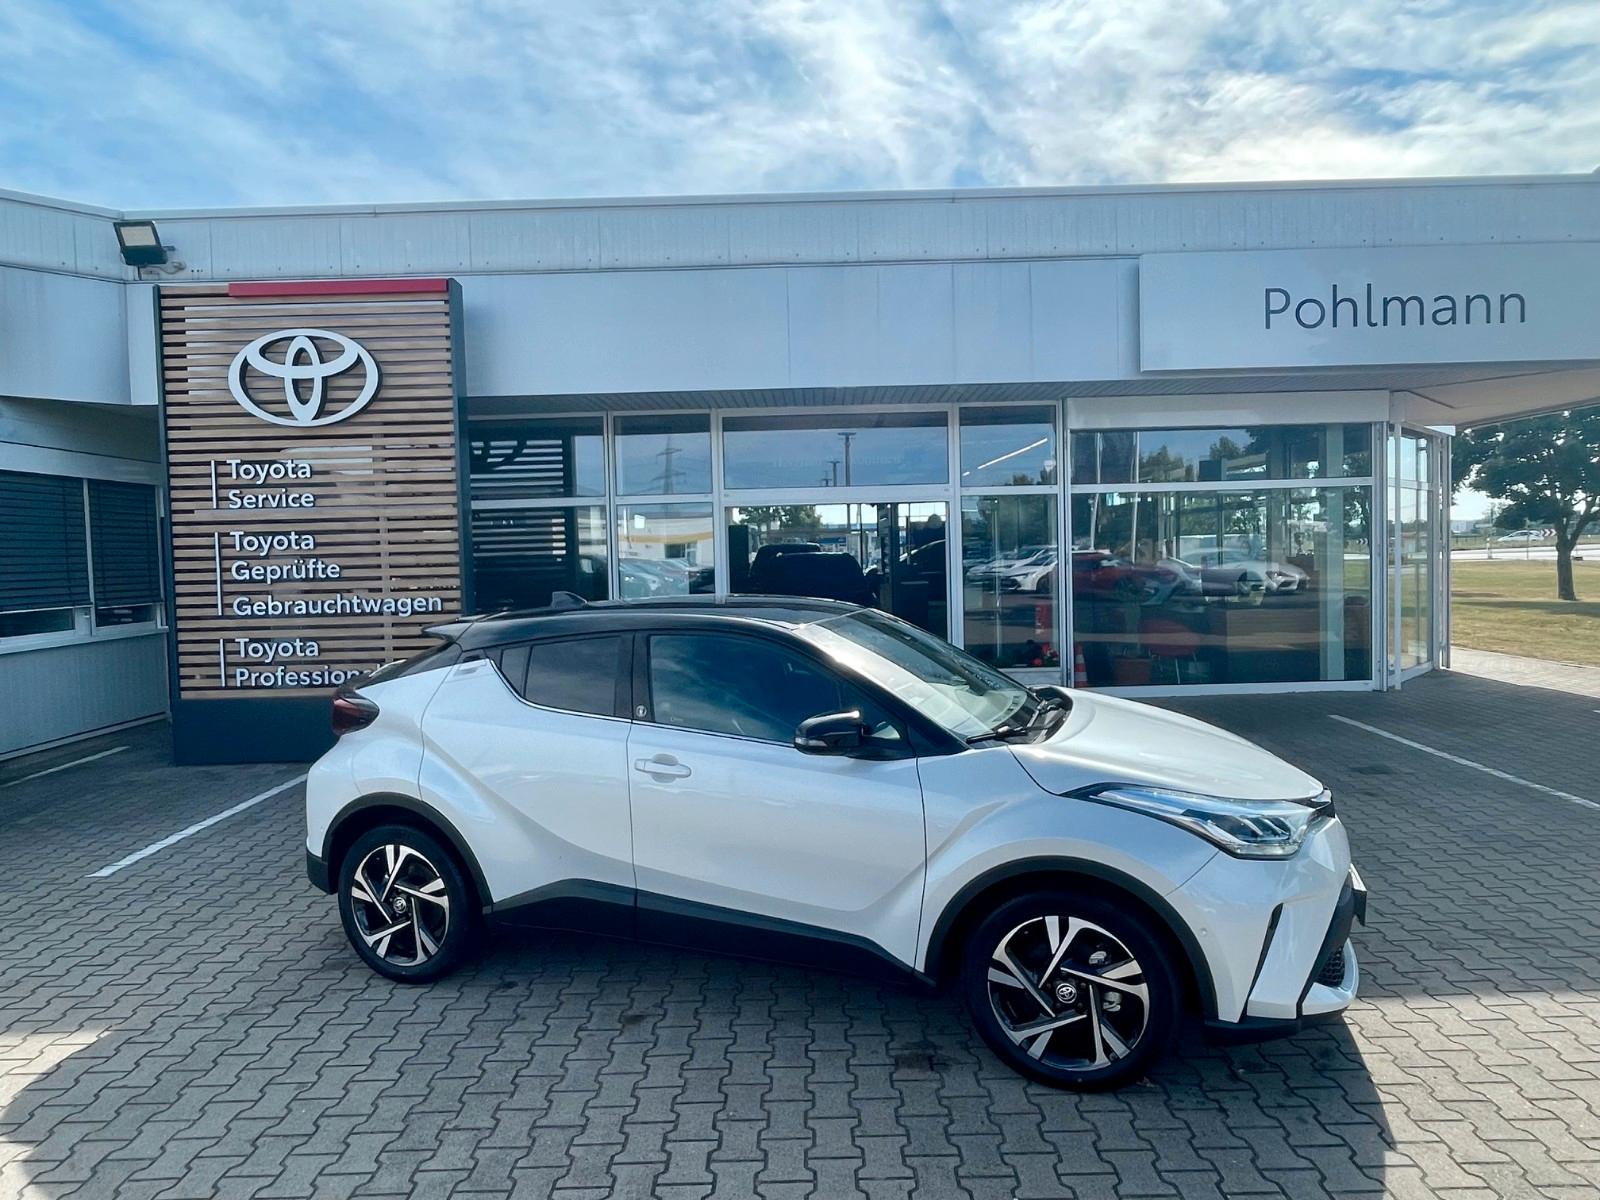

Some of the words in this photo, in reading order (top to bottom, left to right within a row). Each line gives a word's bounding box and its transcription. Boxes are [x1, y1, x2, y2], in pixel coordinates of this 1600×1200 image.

[1265, 283, 1526, 330] Pohlmann
[226, 459, 312, 485] Toyota
[228, 488, 315, 509] Service
[230, 531, 315, 555] Toyota
[231, 559, 341, 584] Geprüfte
[233, 594, 443, 617] Gebrauchtwagen
[235, 638, 320, 662] Toyota
[236, 664, 381, 688] Professio
